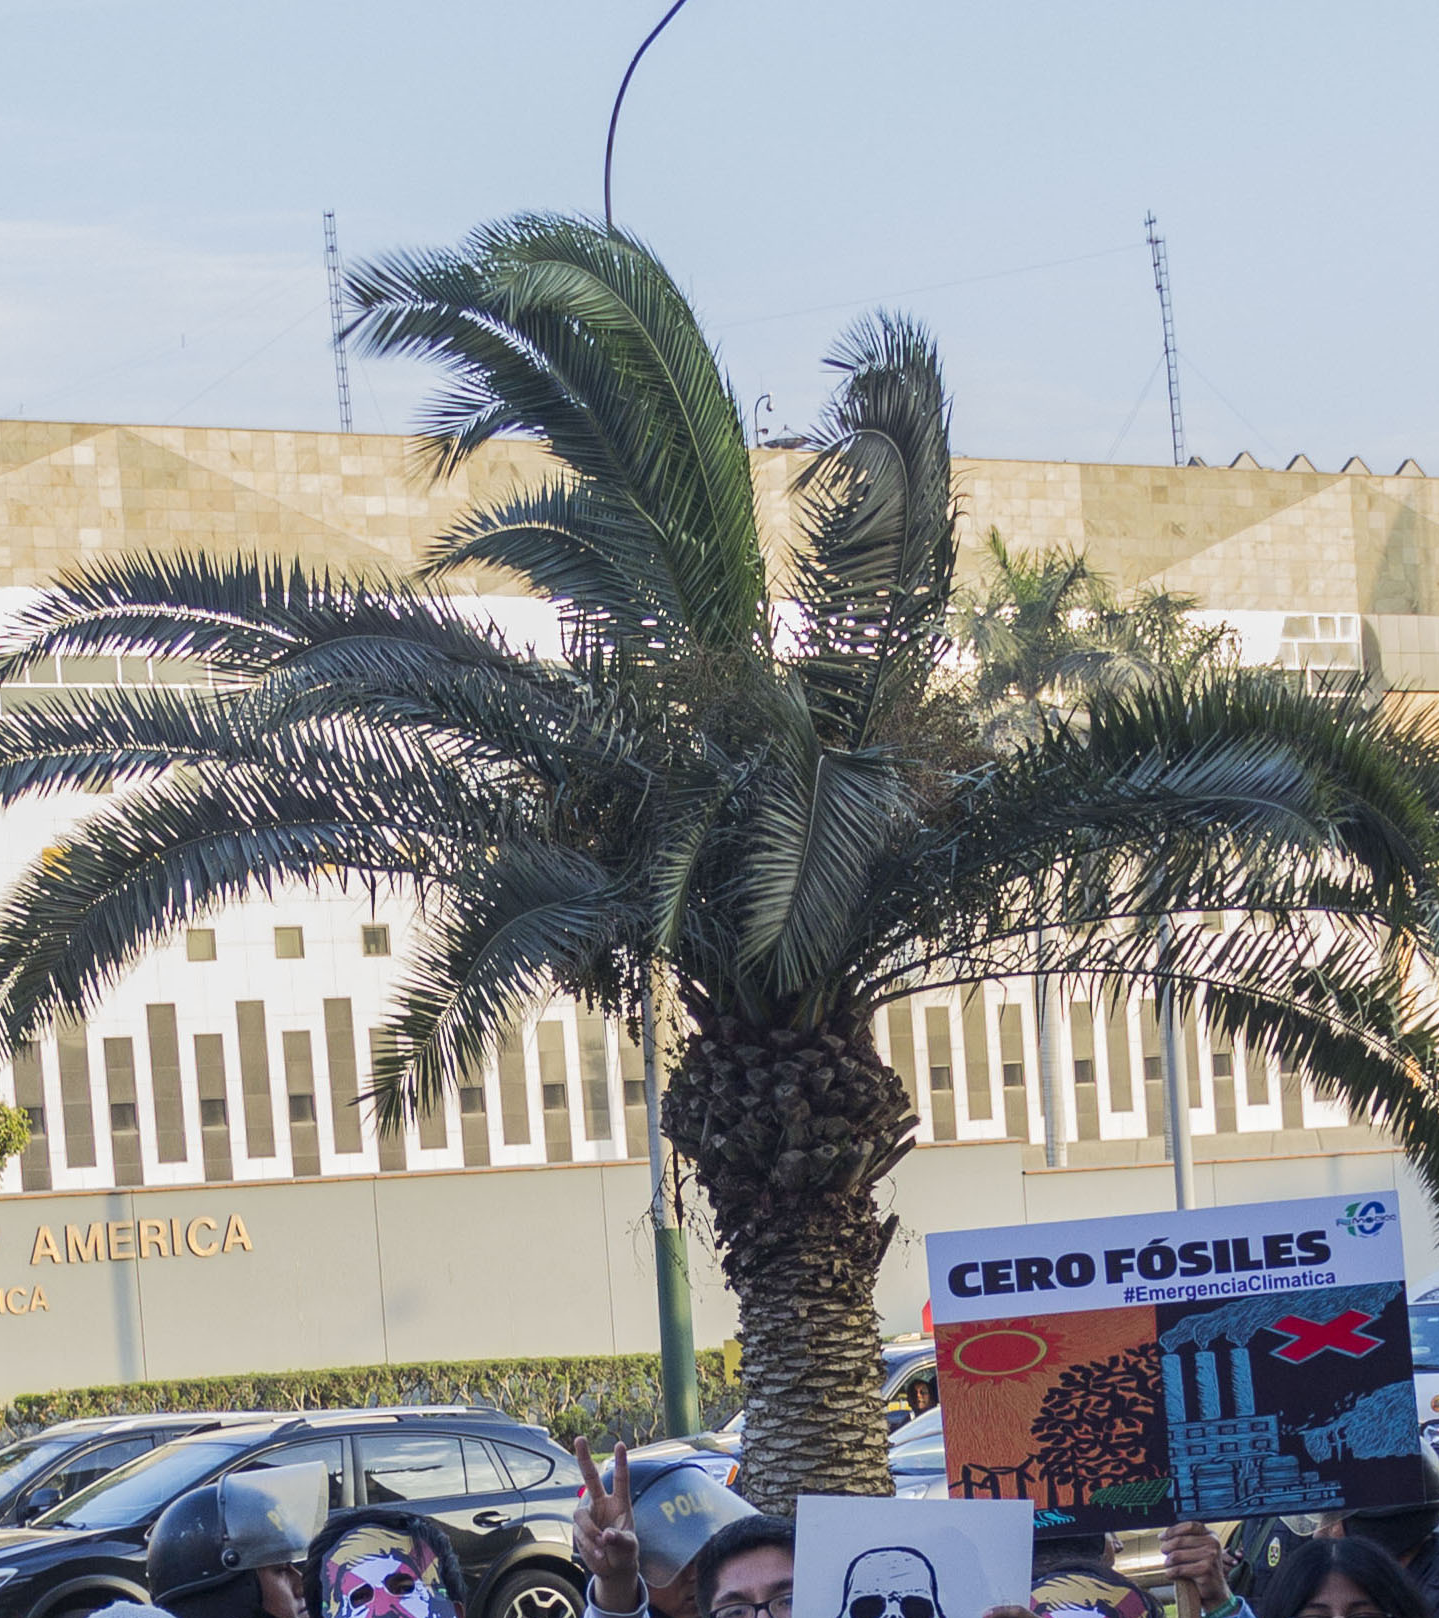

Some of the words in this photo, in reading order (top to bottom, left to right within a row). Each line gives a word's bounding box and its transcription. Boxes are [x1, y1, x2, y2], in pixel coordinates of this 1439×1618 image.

[29, 1213, 255, 1267] AMERICA
[948, 1251, 1096, 1298] CERO
[1104, 1230, 1332, 1285] FÓSILES
[1124, 1270, 1336, 1303] #EmergenciaClimatica
